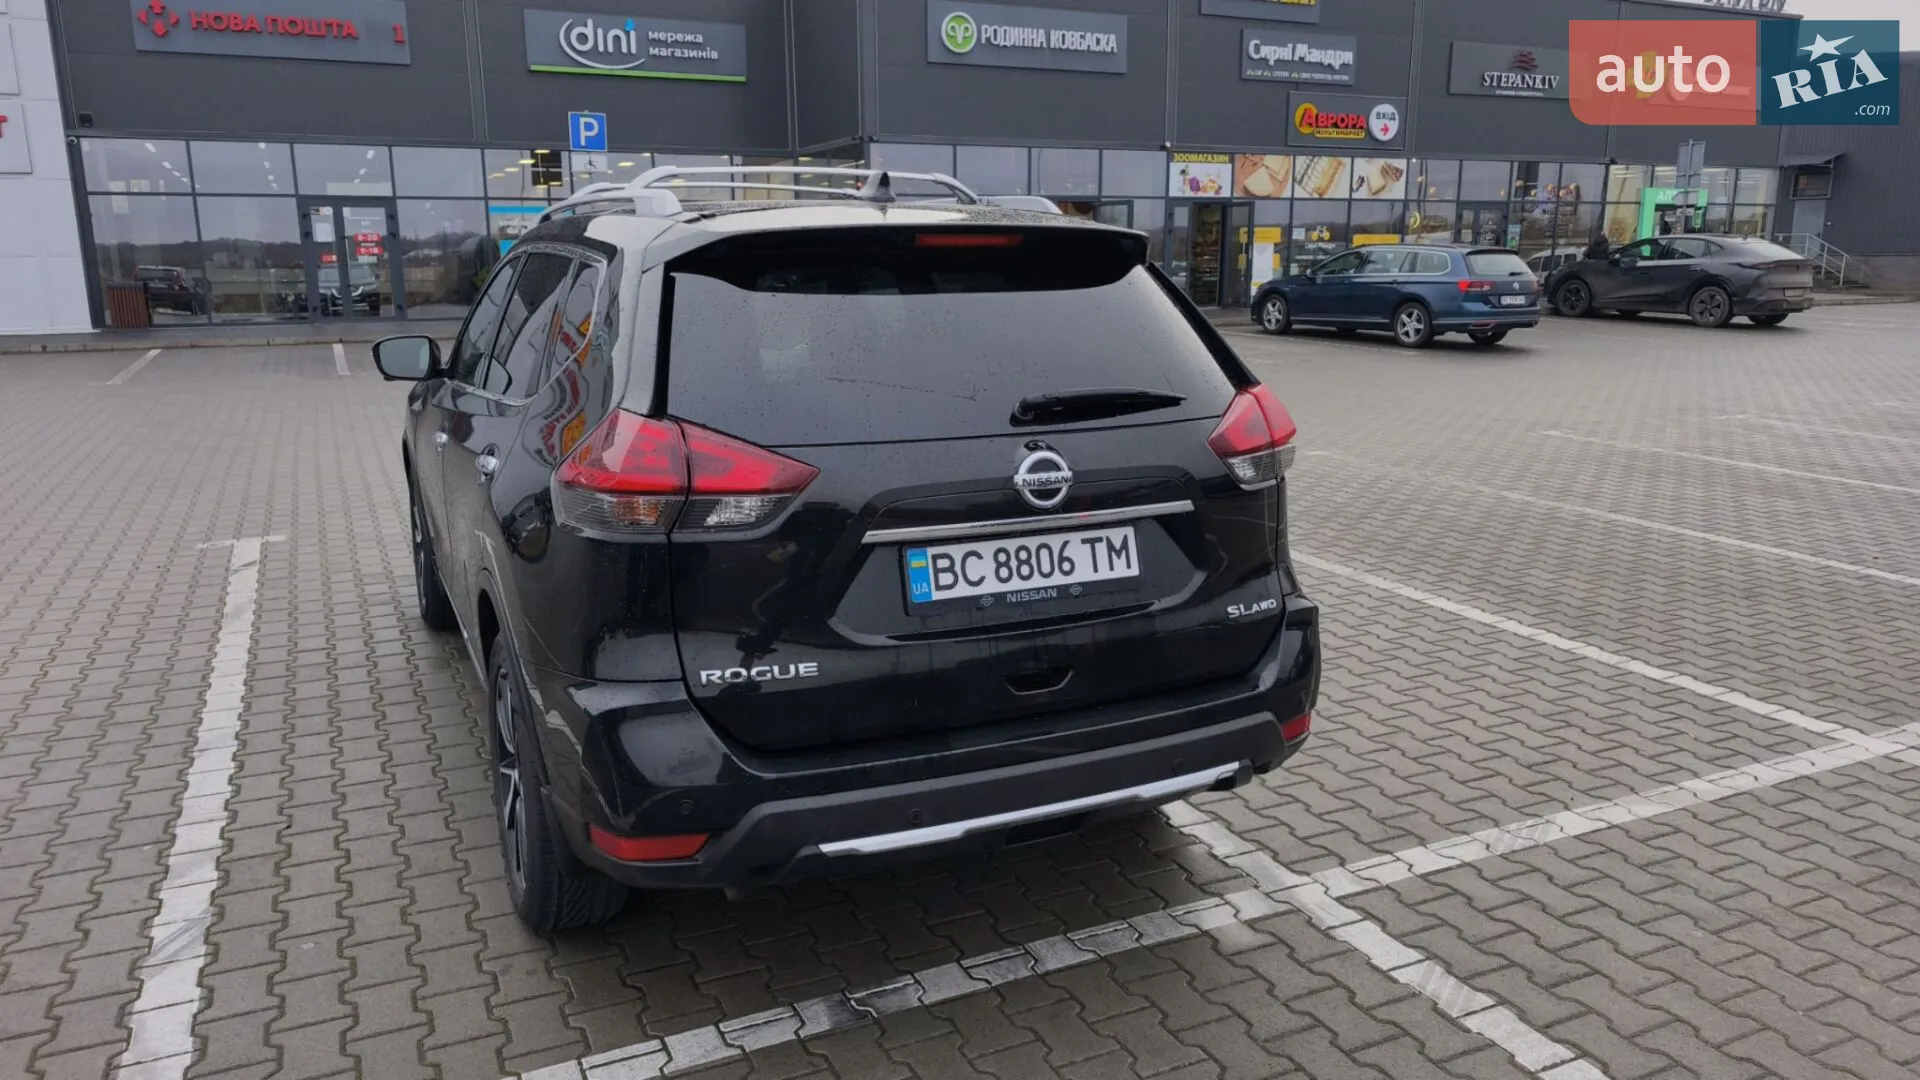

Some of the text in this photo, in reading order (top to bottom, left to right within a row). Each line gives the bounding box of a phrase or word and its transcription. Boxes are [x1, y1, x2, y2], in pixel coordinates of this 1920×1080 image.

[190, 11, 405, 43] НОВА ПОШТА 1
[569, 17, 636, 55] dini
[648, 30, 704, 44] мережа
[981, 24, 1118, 53] РОДИННА КОВБАСКА
[649, 46, 719, 60] магазинів
[1247, 39, 1353, 71] Сирні Мандри
[1482, 71, 1560, 89] STEPANKIV
[1301, 107, 1368, 129] АВРОРА
[1375, 111, 1397, 121] ВХІД
[1173, 152, 1229, 163] ЗООМАГАЗИН
[1022, 474, 1070, 487] NISSAN
[931, 534, 1132, 592] BC 8806 TM
[913, 582, 929, 595] UA
[1006, 587, 1057, 603] NISSAN
[1251, 599, 1277, 614] AWD
[700, 662, 819, 685] ROGUE
